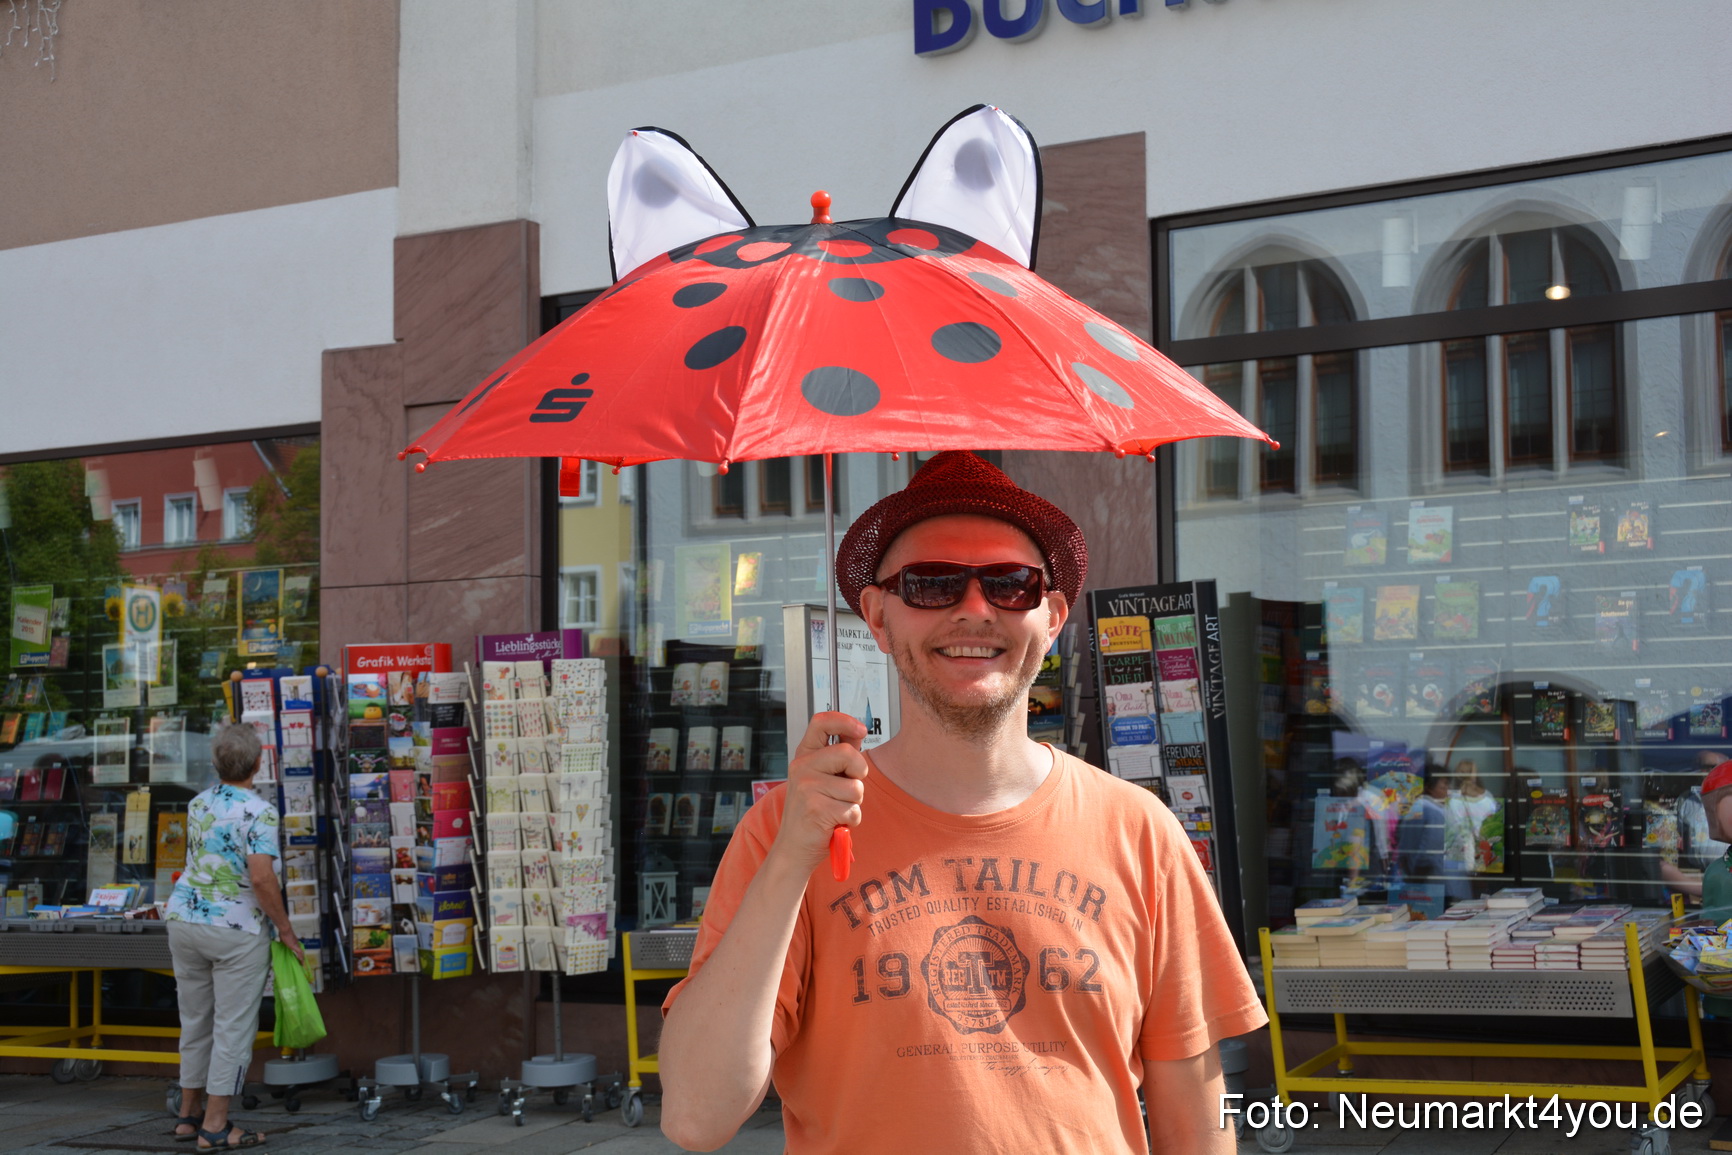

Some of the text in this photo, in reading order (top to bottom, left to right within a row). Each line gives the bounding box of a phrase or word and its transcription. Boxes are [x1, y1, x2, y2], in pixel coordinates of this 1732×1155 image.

[17, 615, 42, 626] Kalender
[1103, 625, 1142, 638] GUTE
[356, 654, 432, 668] Grafik Werksta
[1108, 655, 1144, 667] CARPE
[1115, 691, 1133, 701] Oma
[1165, 745, 1201, 759] FREUNDE
[828, 855, 1107, 931] TOM TAILOR
[867, 897, 1083, 937] TRUSTED QUALITY ESTABLISHED IN
[930, 925, 1023, 997] REGISTERED TRADEMARK
[946, 1001, 978, 1009] established
[957, 1014, 1000, 1027] 957872
[896, 1041, 1068, 1058] GENERAL PURPOSE UTILITY
